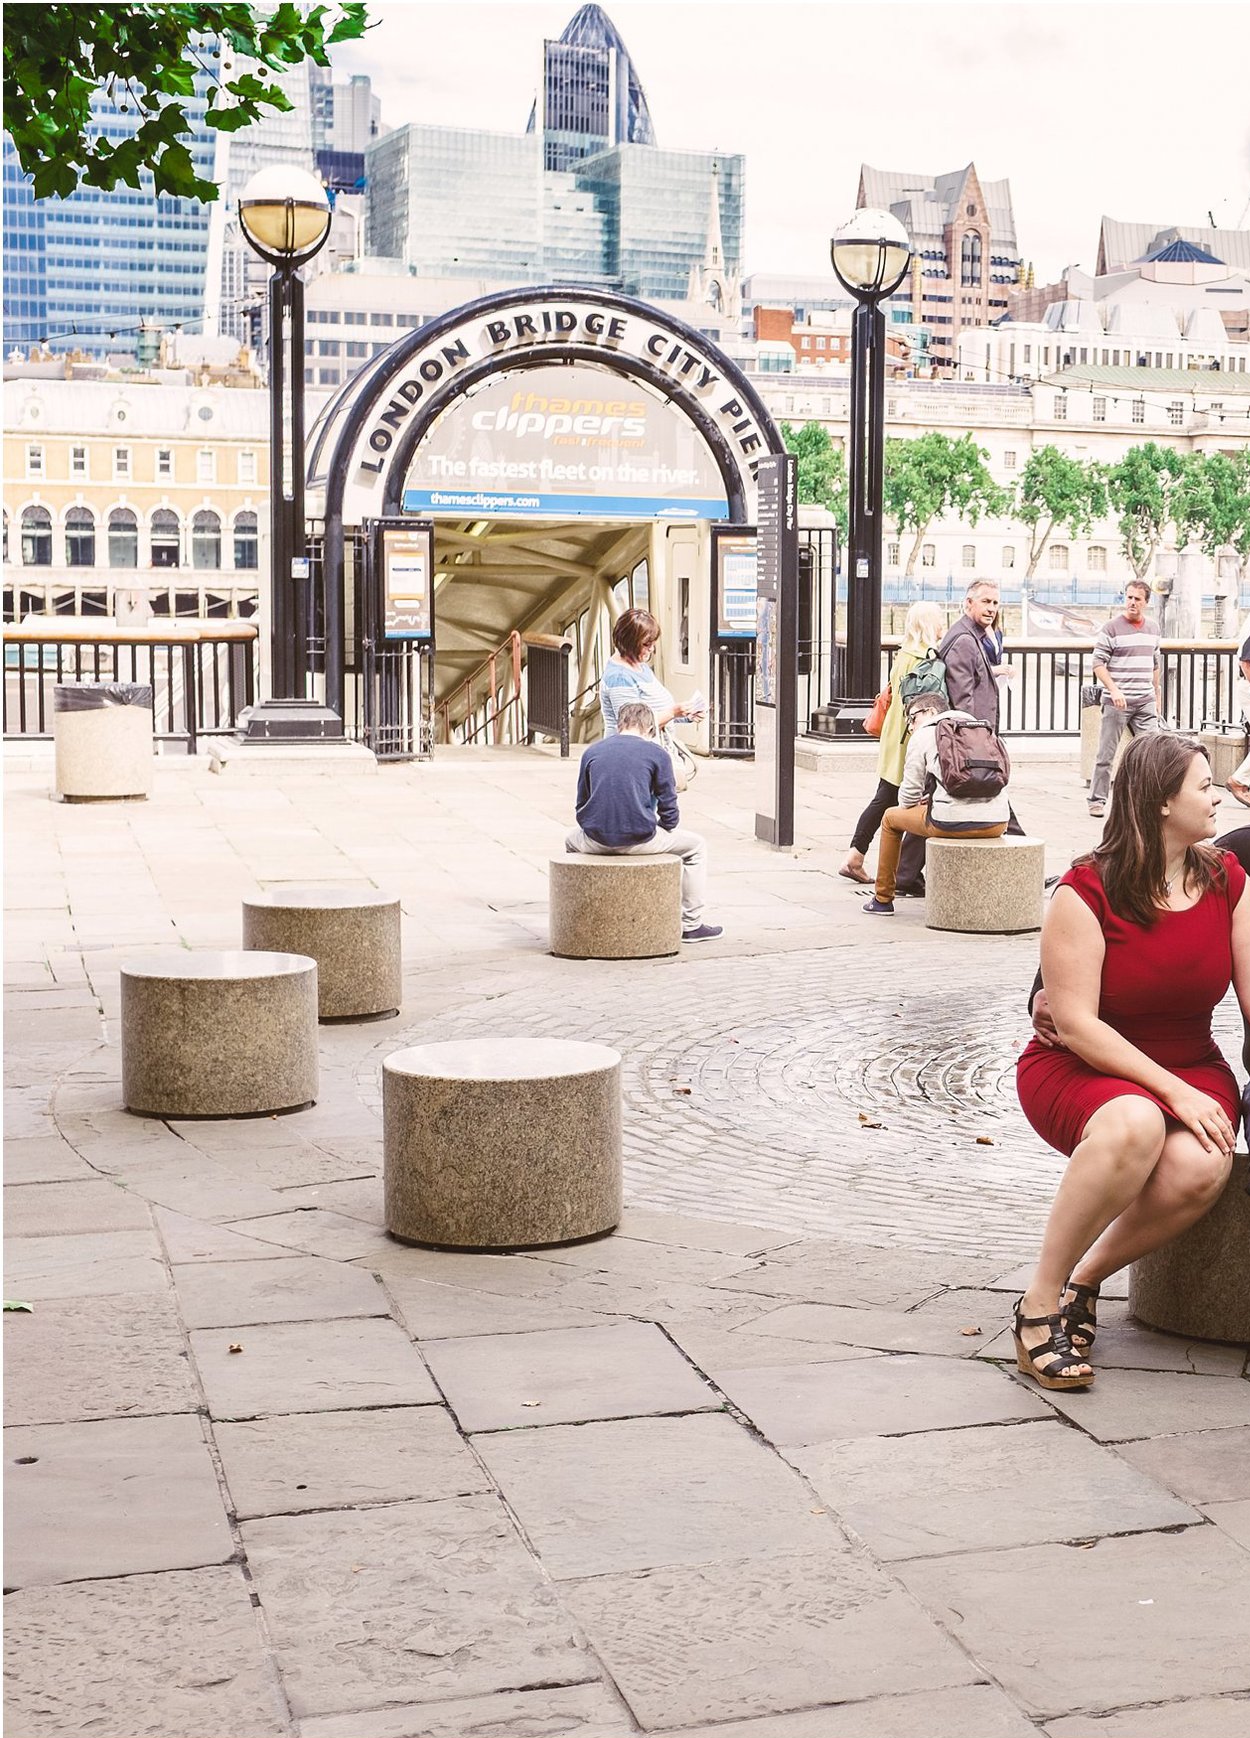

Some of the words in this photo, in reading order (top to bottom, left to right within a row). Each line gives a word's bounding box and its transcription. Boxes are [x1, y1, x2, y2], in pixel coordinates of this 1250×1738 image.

[361, 338, 471, 474] LONDON
[486, 311, 628, 344] BRIDGE
[647, 334, 720, 388] CITY
[511, 390, 646, 417] thames
[472, 406, 646, 439] clippers
[427, 455, 466, 477] The
[468, 457, 537, 479] fastest
[538, 458, 587, 481] fleet
[588, 466, 616, 482] on
[617, 462, 650, 483] the
[651, 464, 700, 485] river.
[430, 491, 540, 510] thamesclippers.com
